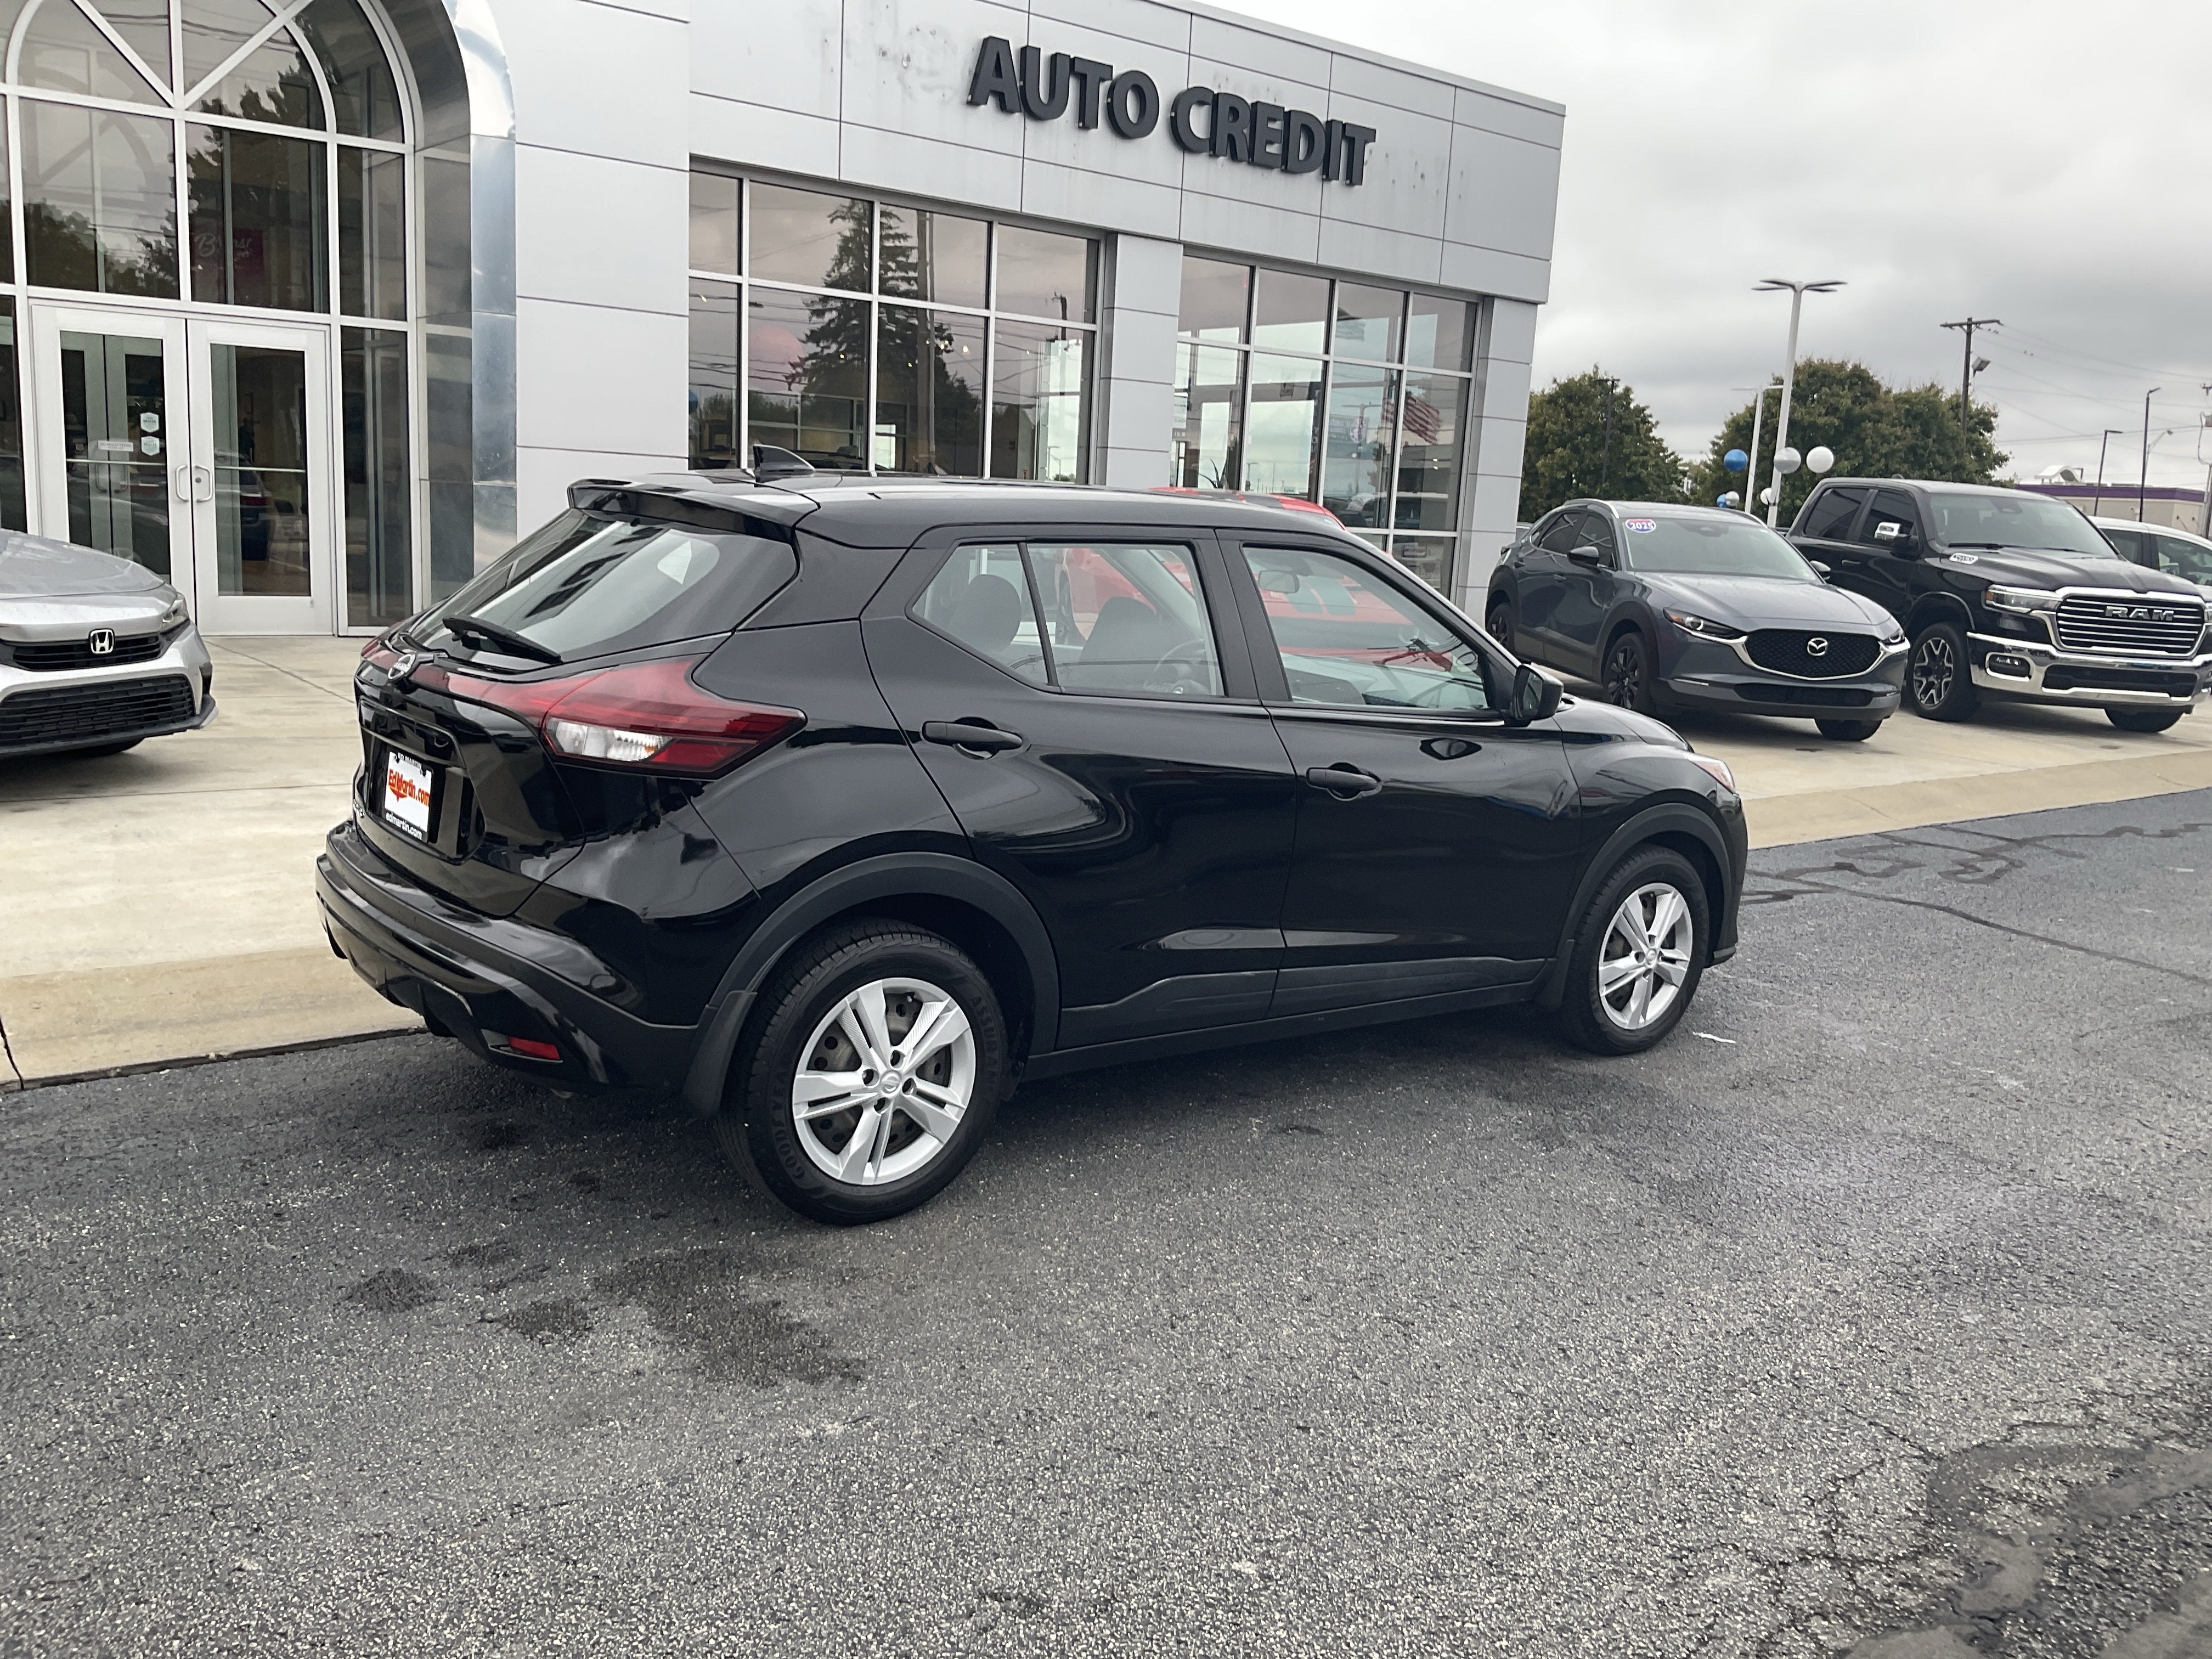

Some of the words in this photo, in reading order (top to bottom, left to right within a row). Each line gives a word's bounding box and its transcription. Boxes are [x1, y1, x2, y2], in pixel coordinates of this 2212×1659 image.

[967, 36, 1159, 139] AUTO
[1170, 86, 1376, 186] CREDIT
[2106, 606, 2174, 621] RAM
[386, 812, 422, 840] edmartin.com
